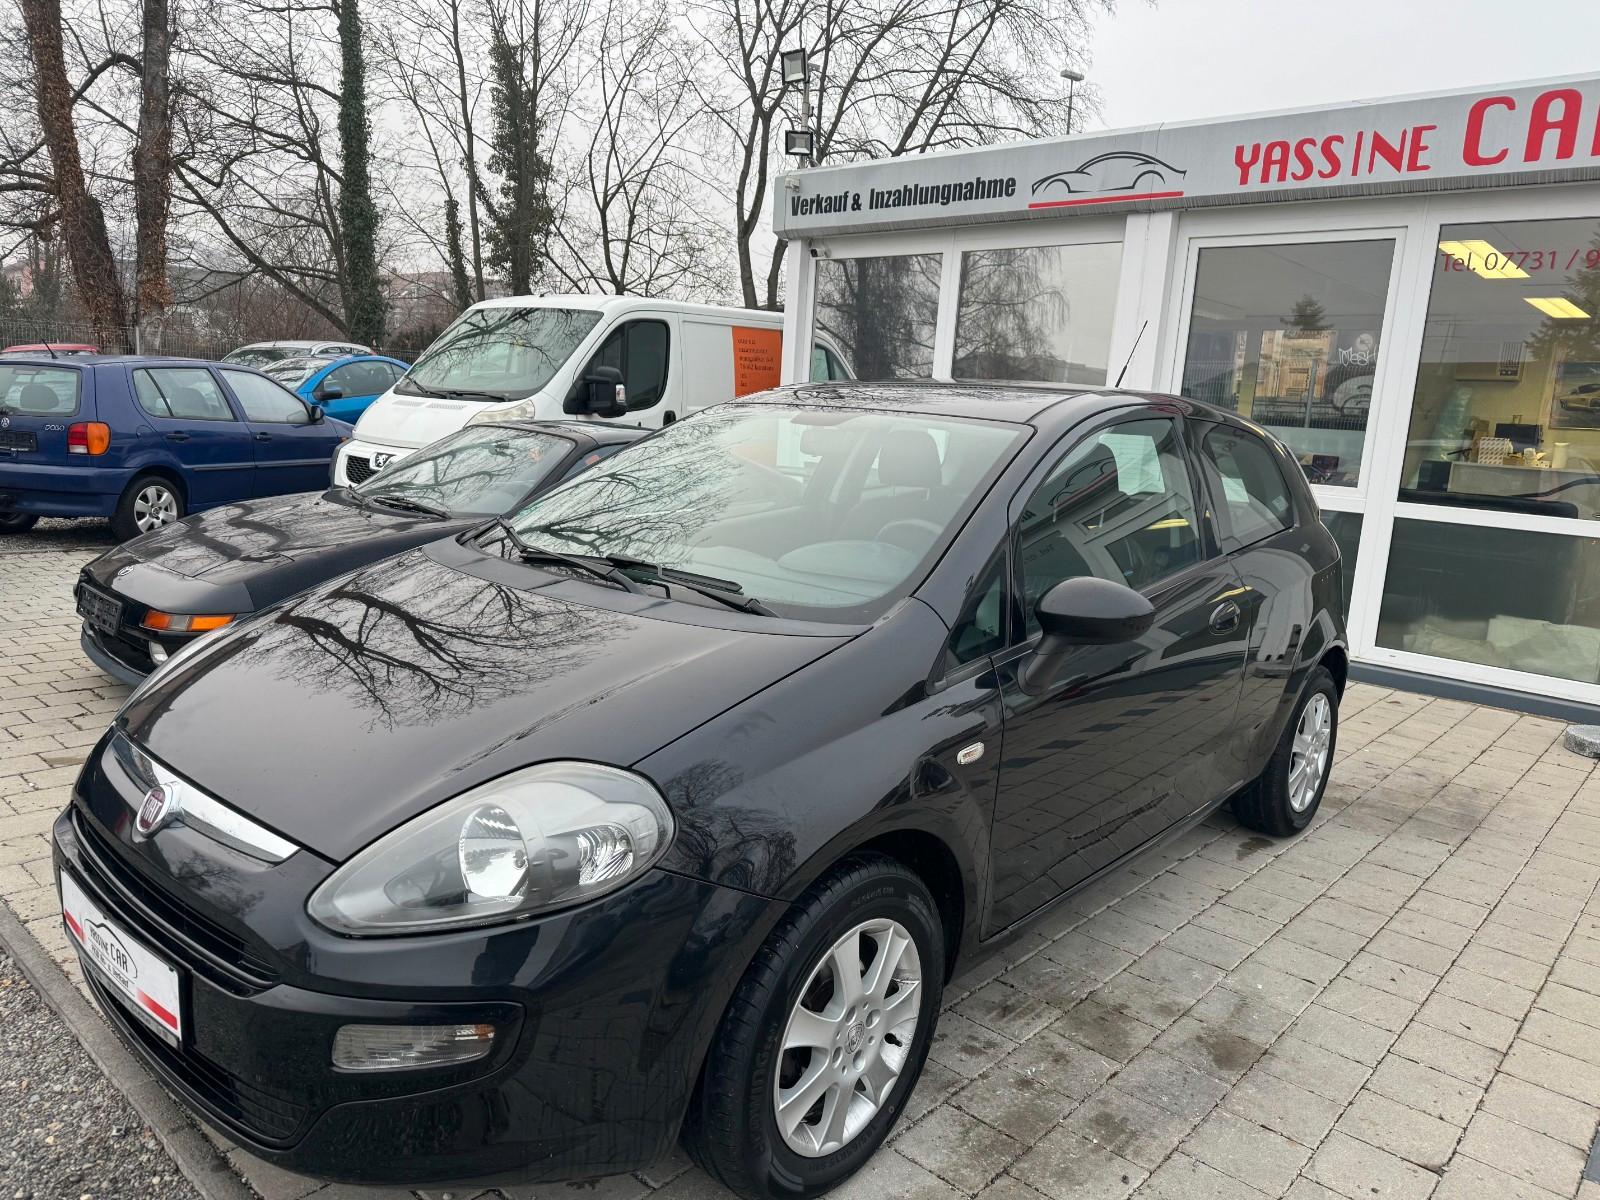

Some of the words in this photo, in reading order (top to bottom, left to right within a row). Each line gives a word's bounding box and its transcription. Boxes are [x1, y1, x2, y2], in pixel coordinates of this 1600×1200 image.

[1234, 125, 1438, 185] YASSINE
[1463, 88, 1600, 167] CA
[791, 191, 850, 216] Verkauf
[851, 192, 862, 212] &
[868, 176, 1017, 210] Inzahlungnahme
[1441, 252, 1476, 272] Tel.
[1484, 250, 1556, 271] 07731
[141, 797, 163, 823] FIAT
[110, 943, 128, 972] CAR
